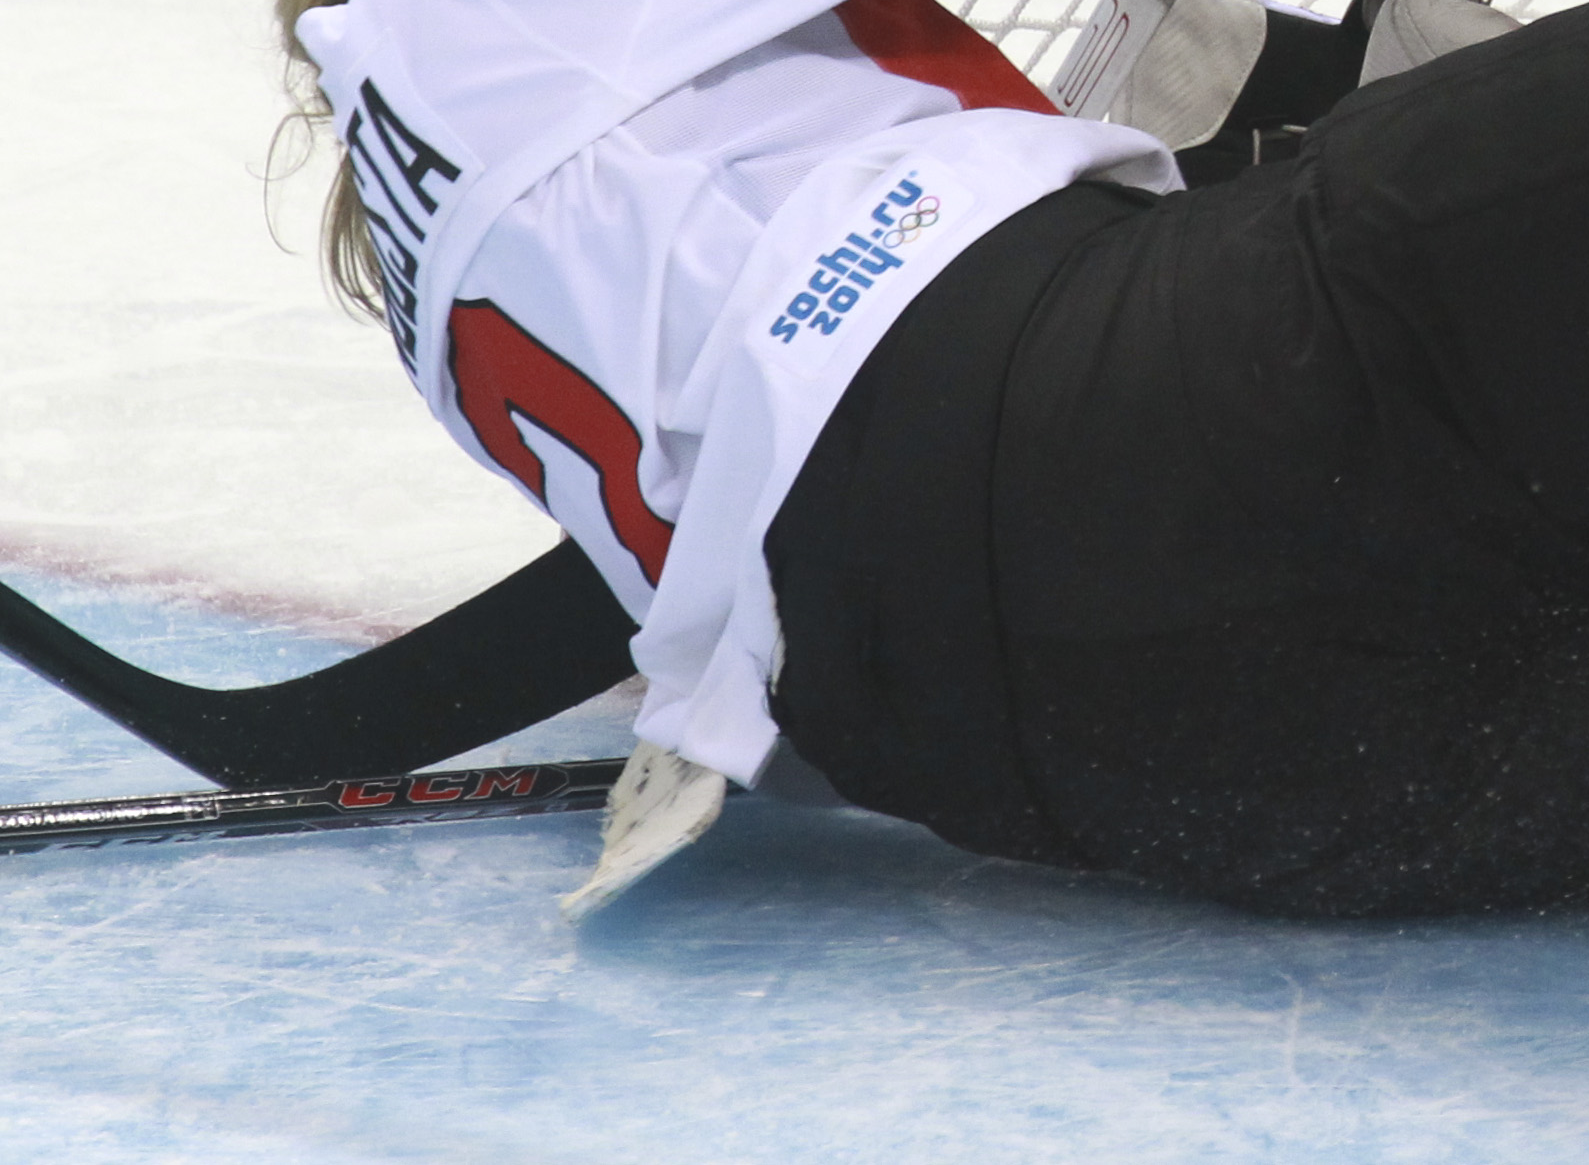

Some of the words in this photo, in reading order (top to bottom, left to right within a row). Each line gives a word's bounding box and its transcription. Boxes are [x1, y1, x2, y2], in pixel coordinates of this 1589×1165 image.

[768, 179, 923, 345] sochi.ru
[807, 245, 906, 336] 2014
[338, 766, 542, 810] CCM
